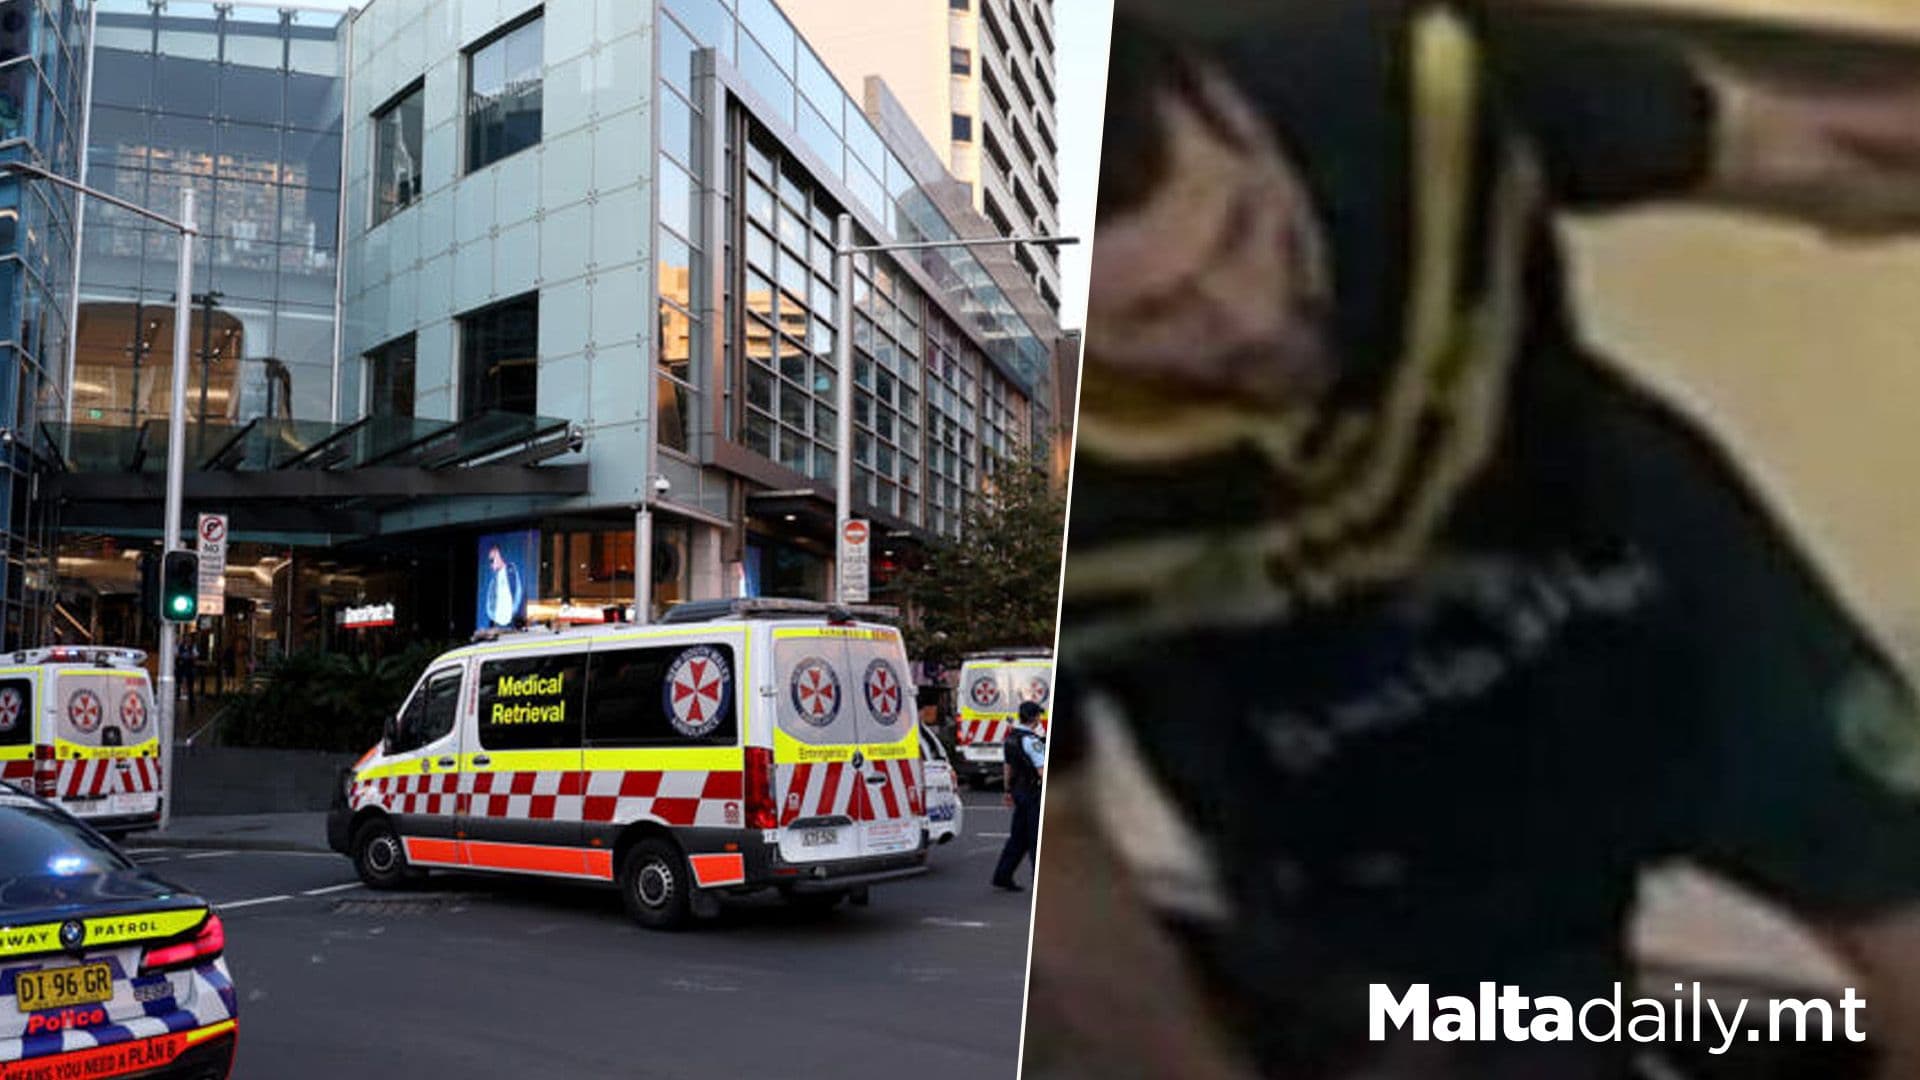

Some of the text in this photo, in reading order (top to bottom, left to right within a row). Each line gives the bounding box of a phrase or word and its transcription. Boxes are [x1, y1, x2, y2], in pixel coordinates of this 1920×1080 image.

[497, 672, 563, 697] Medical
[491, 701, 565, 724] Retrieval
[95, 921, 157, 936] PATROL
[28, 1009, 105, 1034] Police
[56, 1060, 82, 1079] YOU
[84, 1053, 117, 1075] NEED
[128, 1042, 164, 1066] PLAN
